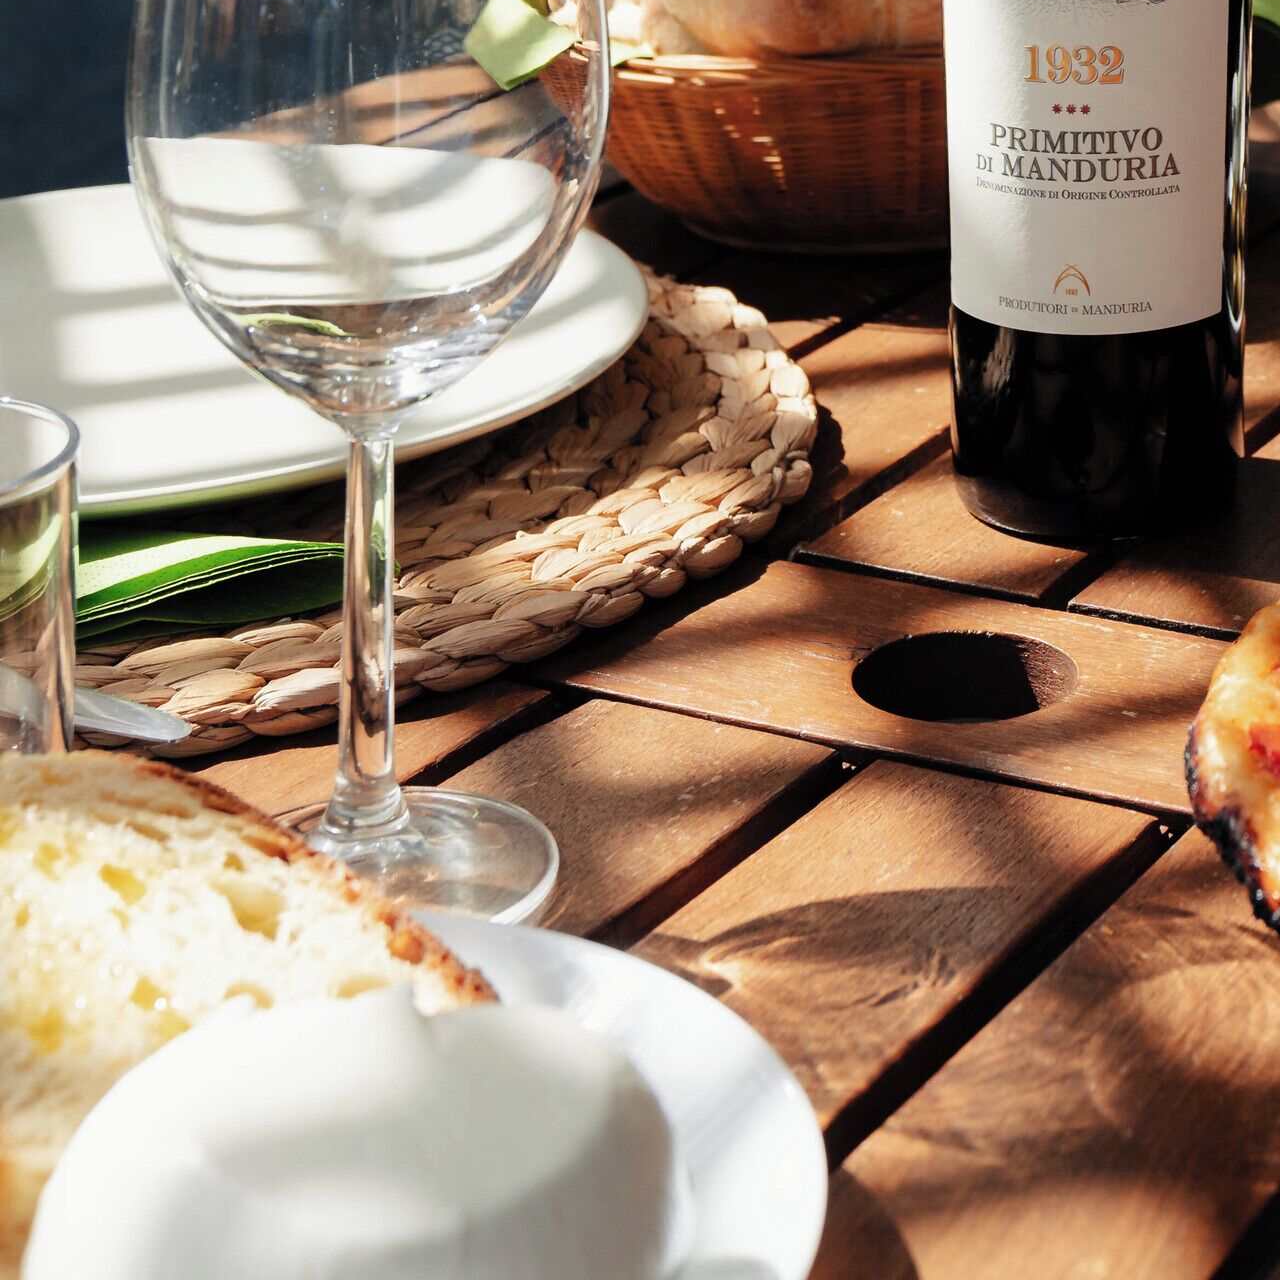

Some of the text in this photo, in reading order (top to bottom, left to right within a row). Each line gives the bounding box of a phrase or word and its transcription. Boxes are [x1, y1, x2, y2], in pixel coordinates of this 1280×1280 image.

[1024, 44, 1125, 85] 1932
[990, 122, 1164, 155] PRIMITIVO
[976, 152, 1181, 183] DI MANDURIA
[998, 296, 1067, 315] PRODUTTORI
[1082, 301, 1153, 316] MANDURIA
